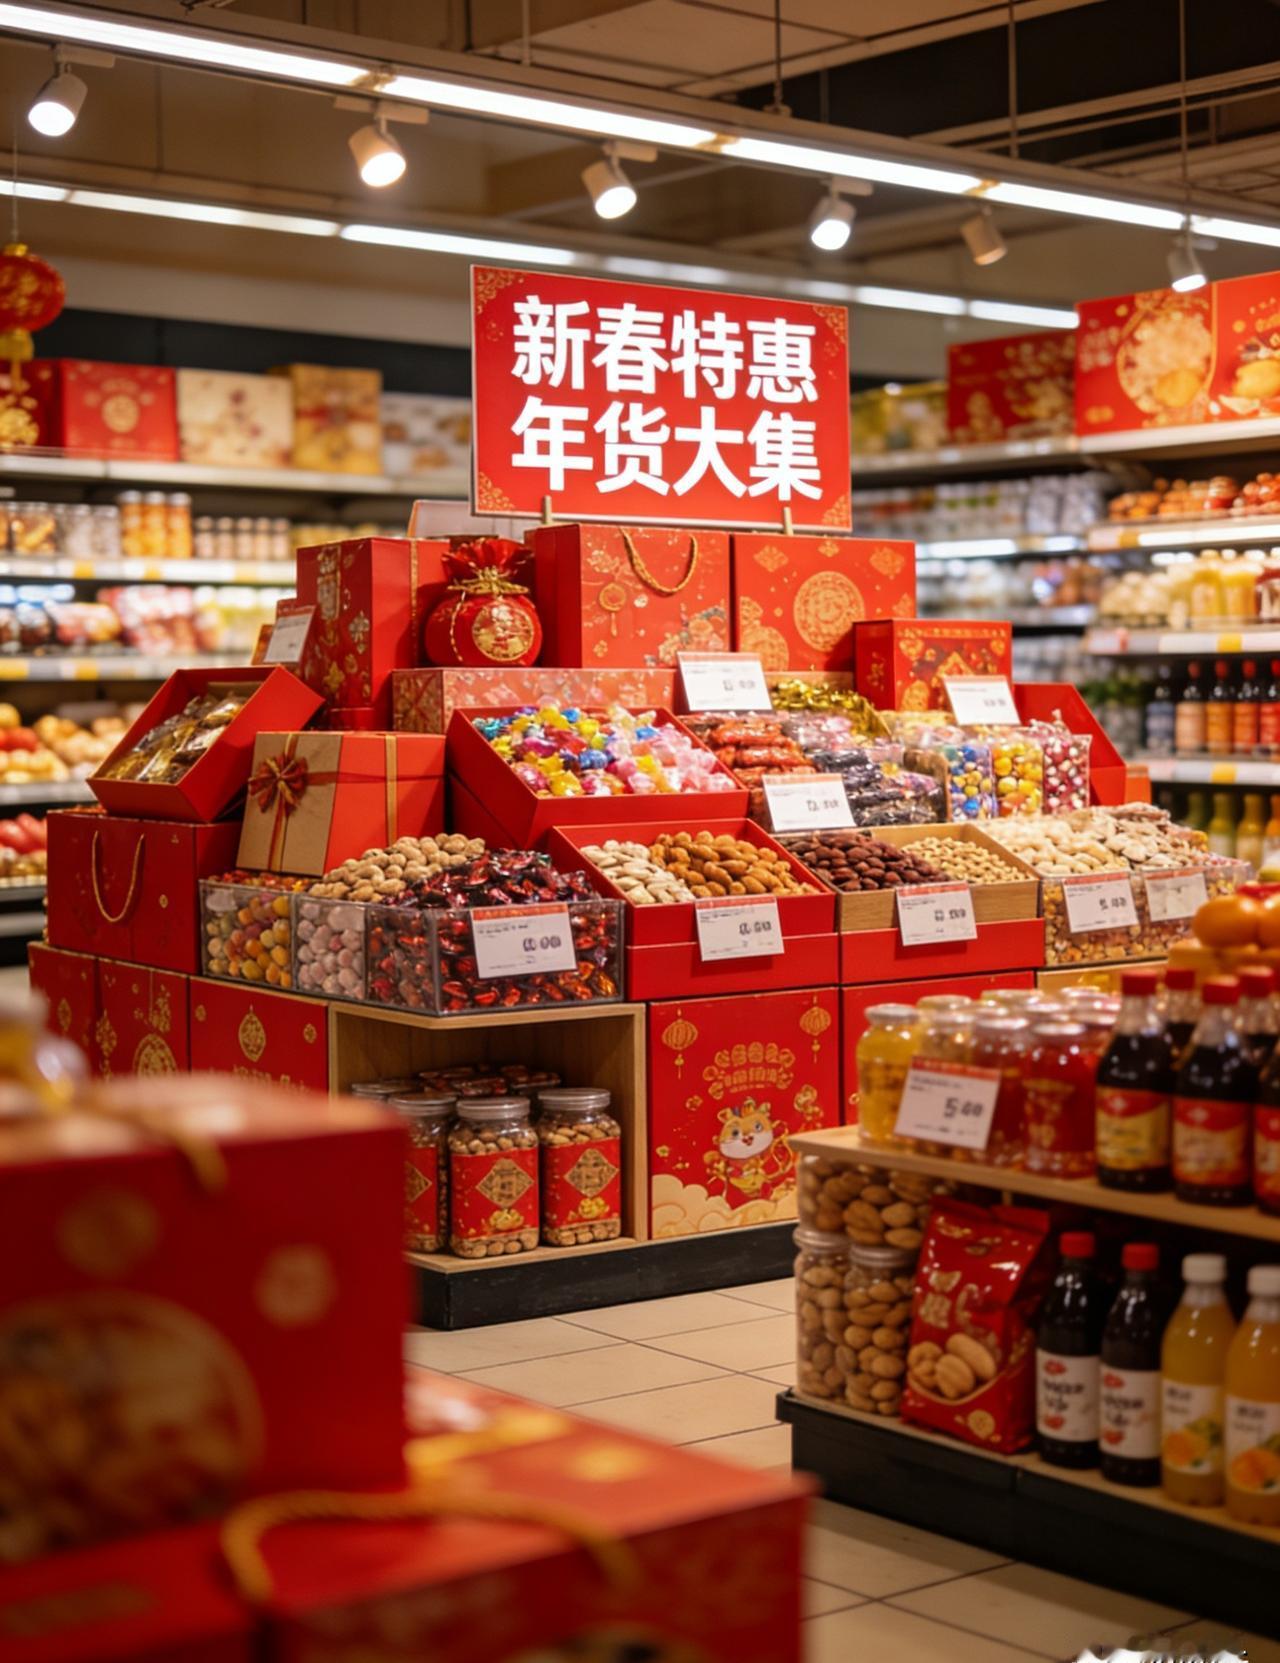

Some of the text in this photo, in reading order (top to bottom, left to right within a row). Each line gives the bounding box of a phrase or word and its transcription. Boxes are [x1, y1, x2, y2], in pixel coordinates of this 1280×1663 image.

[511, 295, 819, 403] 新春特惠
[511, 396, 823, 502] 年货大集
